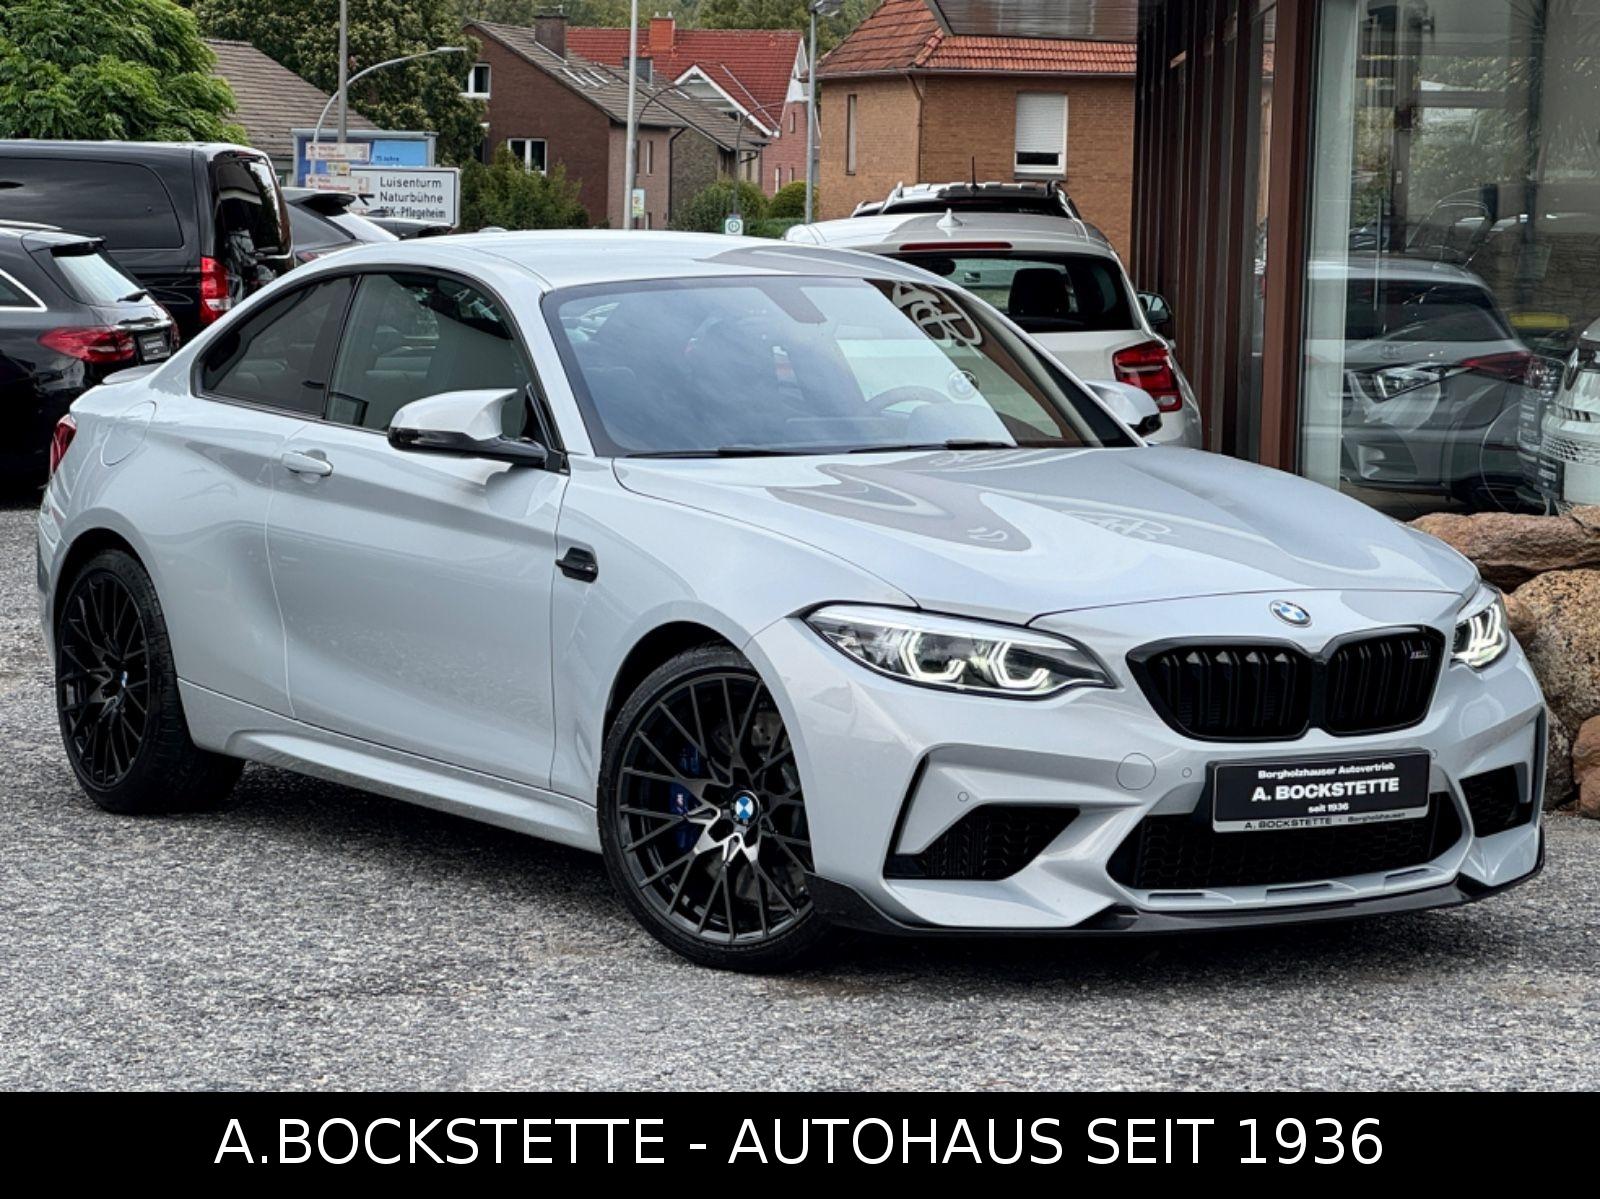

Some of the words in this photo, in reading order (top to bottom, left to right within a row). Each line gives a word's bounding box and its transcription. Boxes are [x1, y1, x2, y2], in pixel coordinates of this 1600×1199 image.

[379, 176, 442, 188] Luisenturm
[379, 191, 443, 204] Naturbühne
[1258, 767, 1336, 780] Borgholzhauser
[1338, 762, 1396, 775] Autovertrieb
[1251, 786, 1272, 801] A.
[1275, 777, 1400, 800] BOCKSTETTE
[1308, 804, 1325, 814] seit
[1327, 802, 1349, 812] 1936
[1258, 817, 1332, 829] BOCKSTETTE
